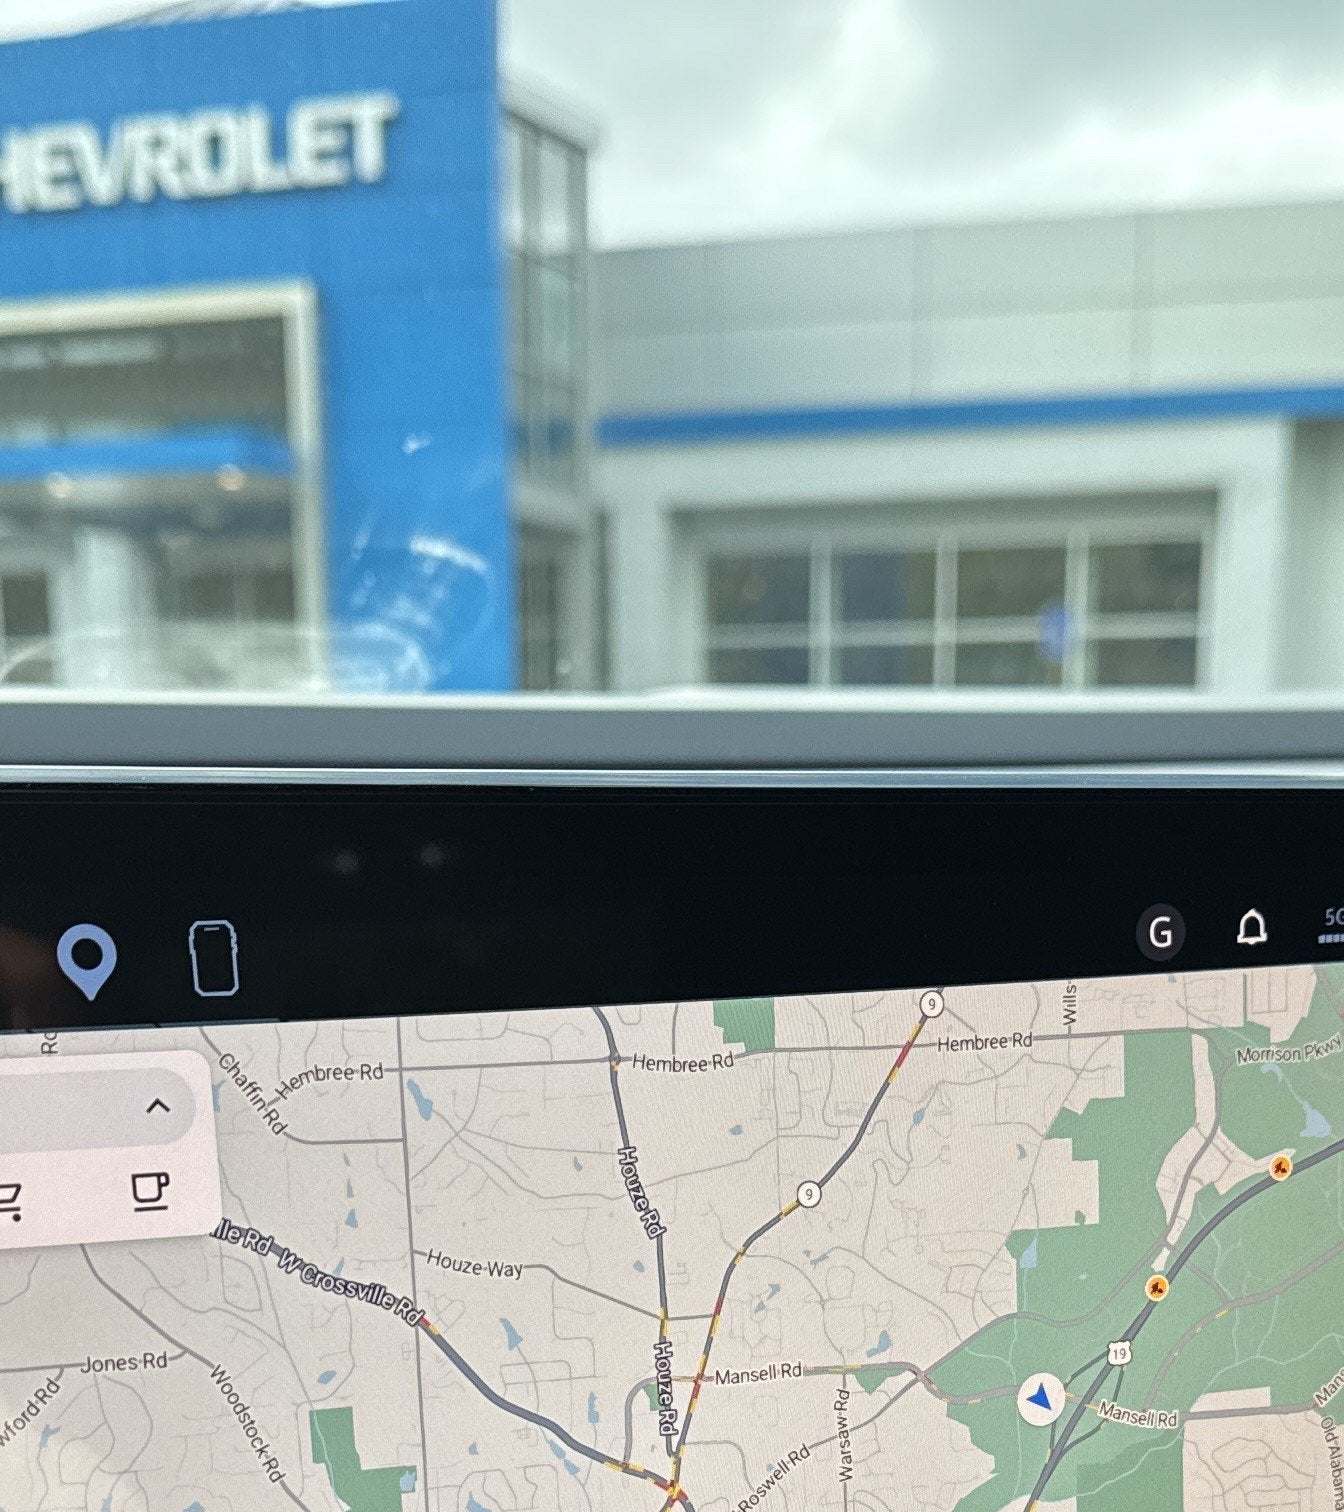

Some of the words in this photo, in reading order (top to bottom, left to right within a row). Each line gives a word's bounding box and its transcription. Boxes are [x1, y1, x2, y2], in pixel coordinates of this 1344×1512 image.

[1149, 915, 1173, 948] G
[1063, 985, 1077, 1025] Wills
[938, 1034, 1008, 1052] Hembree
[1011, 1031, 1033, 1049] Rd
[1237, 1046, 1302, 1063] Morrison
[1305, 1035, 1342, 1059] Pkwy
[632, 1053, 707, 1074] Hembree
[712, 1052, 734, 1070] Rd
[218, 1052, 267, 1112] Chaffin
[261, 1107, 288, 1136] Rd
[274, 1064, 354, 1100] Hembree
[359, 1062, 384, 1080] Rd
[618, 1146, 650, 1212] Houze
[639, 1210, 667, 1239] Rd
[242, 1228, 273, 1256] Rd
[426, 1249, 484, 1276] Houze
[487, 1259, 523, 1280] Way
[277, 1247, 301, 1274] W
[300, 1263, 395, 1310] Crossville
[394, 1296, 425, 1328] Rd
[80, 1355, 137, 1374] Jones
[143, 1351, 168, 1370] Rd
[653, 1341, 675, 1408] Houze
[715, 1364, 777, 1385] Mansell
[781, 1362, 802, 1378] Rd
[33, 1378, 61, 1408] Rd
[834, 1389, 850, 1411] Rd
[210, 1364, 270, 1459] Woodstock
[262, 1457, 285, 1484] Rd
[658, 1408, 679, 1436] Rd
[1099, 1402, 1156, 1428] Mansell
[1158, 1412, 1178, 1427] Rd
[1320, 1417, 1336, 1442] Old
[787, 1444, 811, 1468] Rd
[838, 1416, 853, 1483] Warsaw
[1327, 1446, 1344, 1512] Alabama
